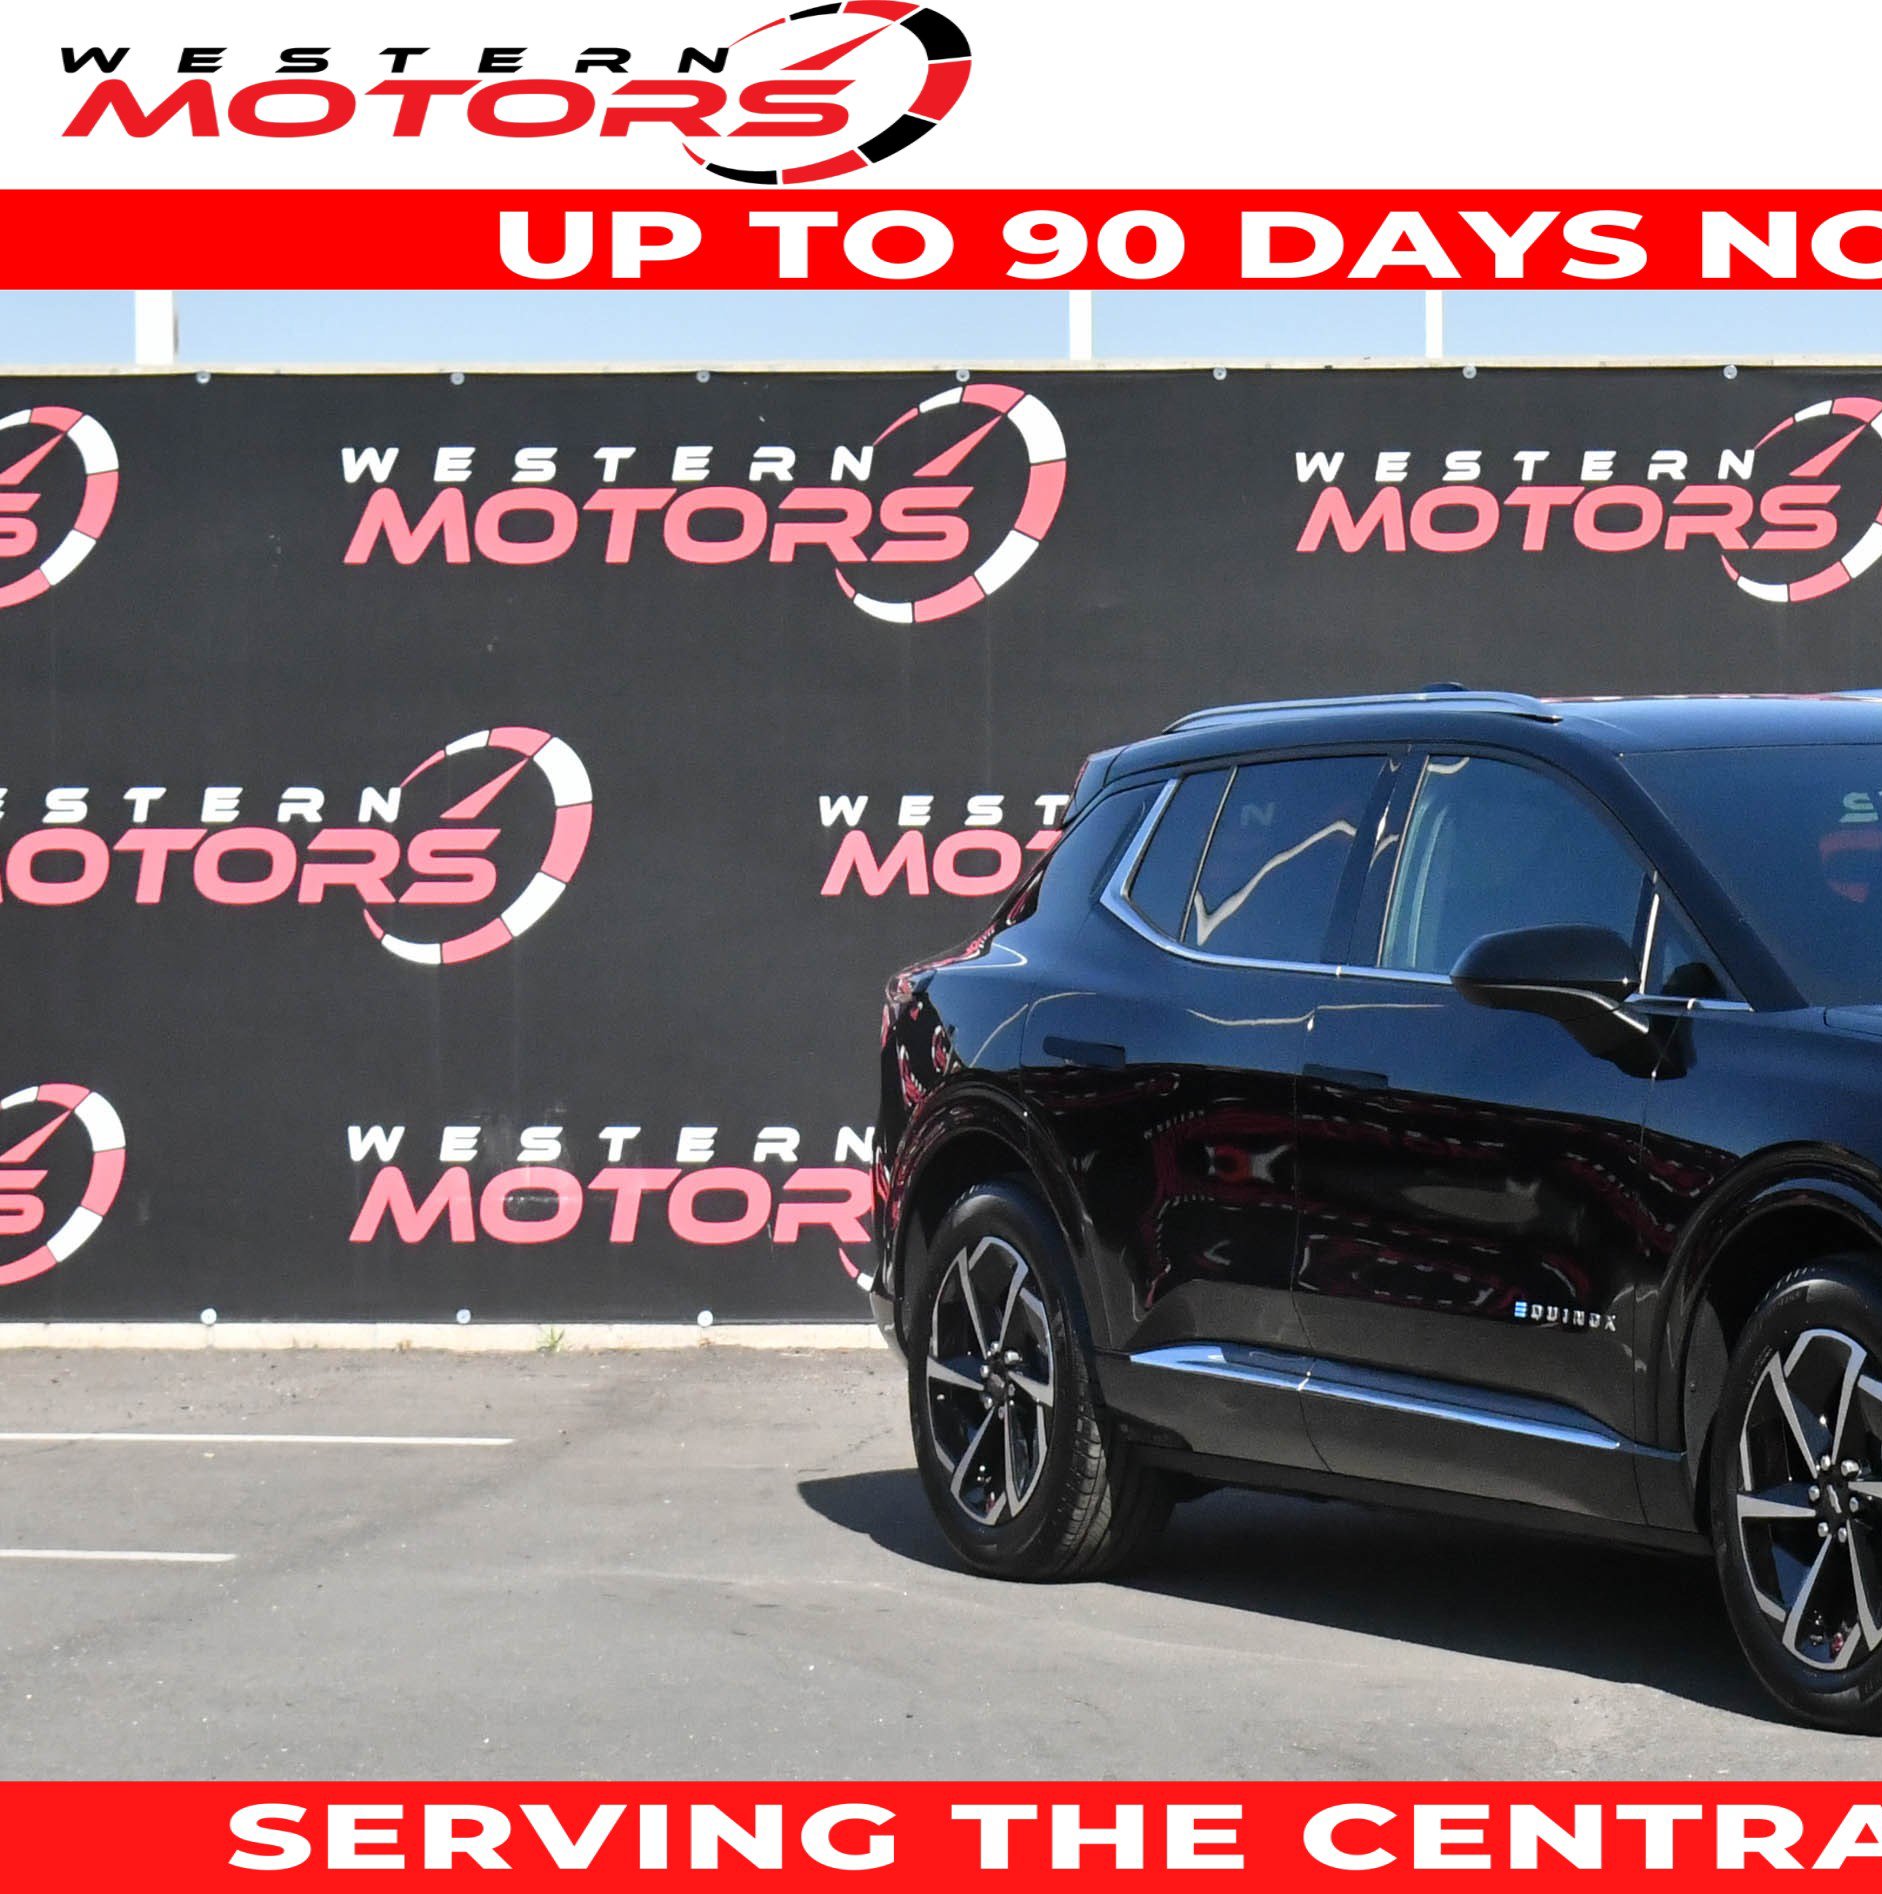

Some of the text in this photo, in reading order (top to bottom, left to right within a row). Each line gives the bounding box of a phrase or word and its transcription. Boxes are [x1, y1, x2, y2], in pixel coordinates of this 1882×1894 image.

[341, 445, 875, 484] WESTERN
[1295, 448, 1757, 483] WESTERN
[342, 485, 975, 566] MOTORS
[1296, 484, 1842, 555] MOTORS
[0, 787, 402, 824] STERN
[819, 794, 1071, 828] WEST
[0, 826, 501, 907] OTORS
[347, 1126, 875, 1164] WESTERN
[349, 1165, 875, 1244] MOTOR
[1514, 1301, 1616, 1332] EQUINOX
